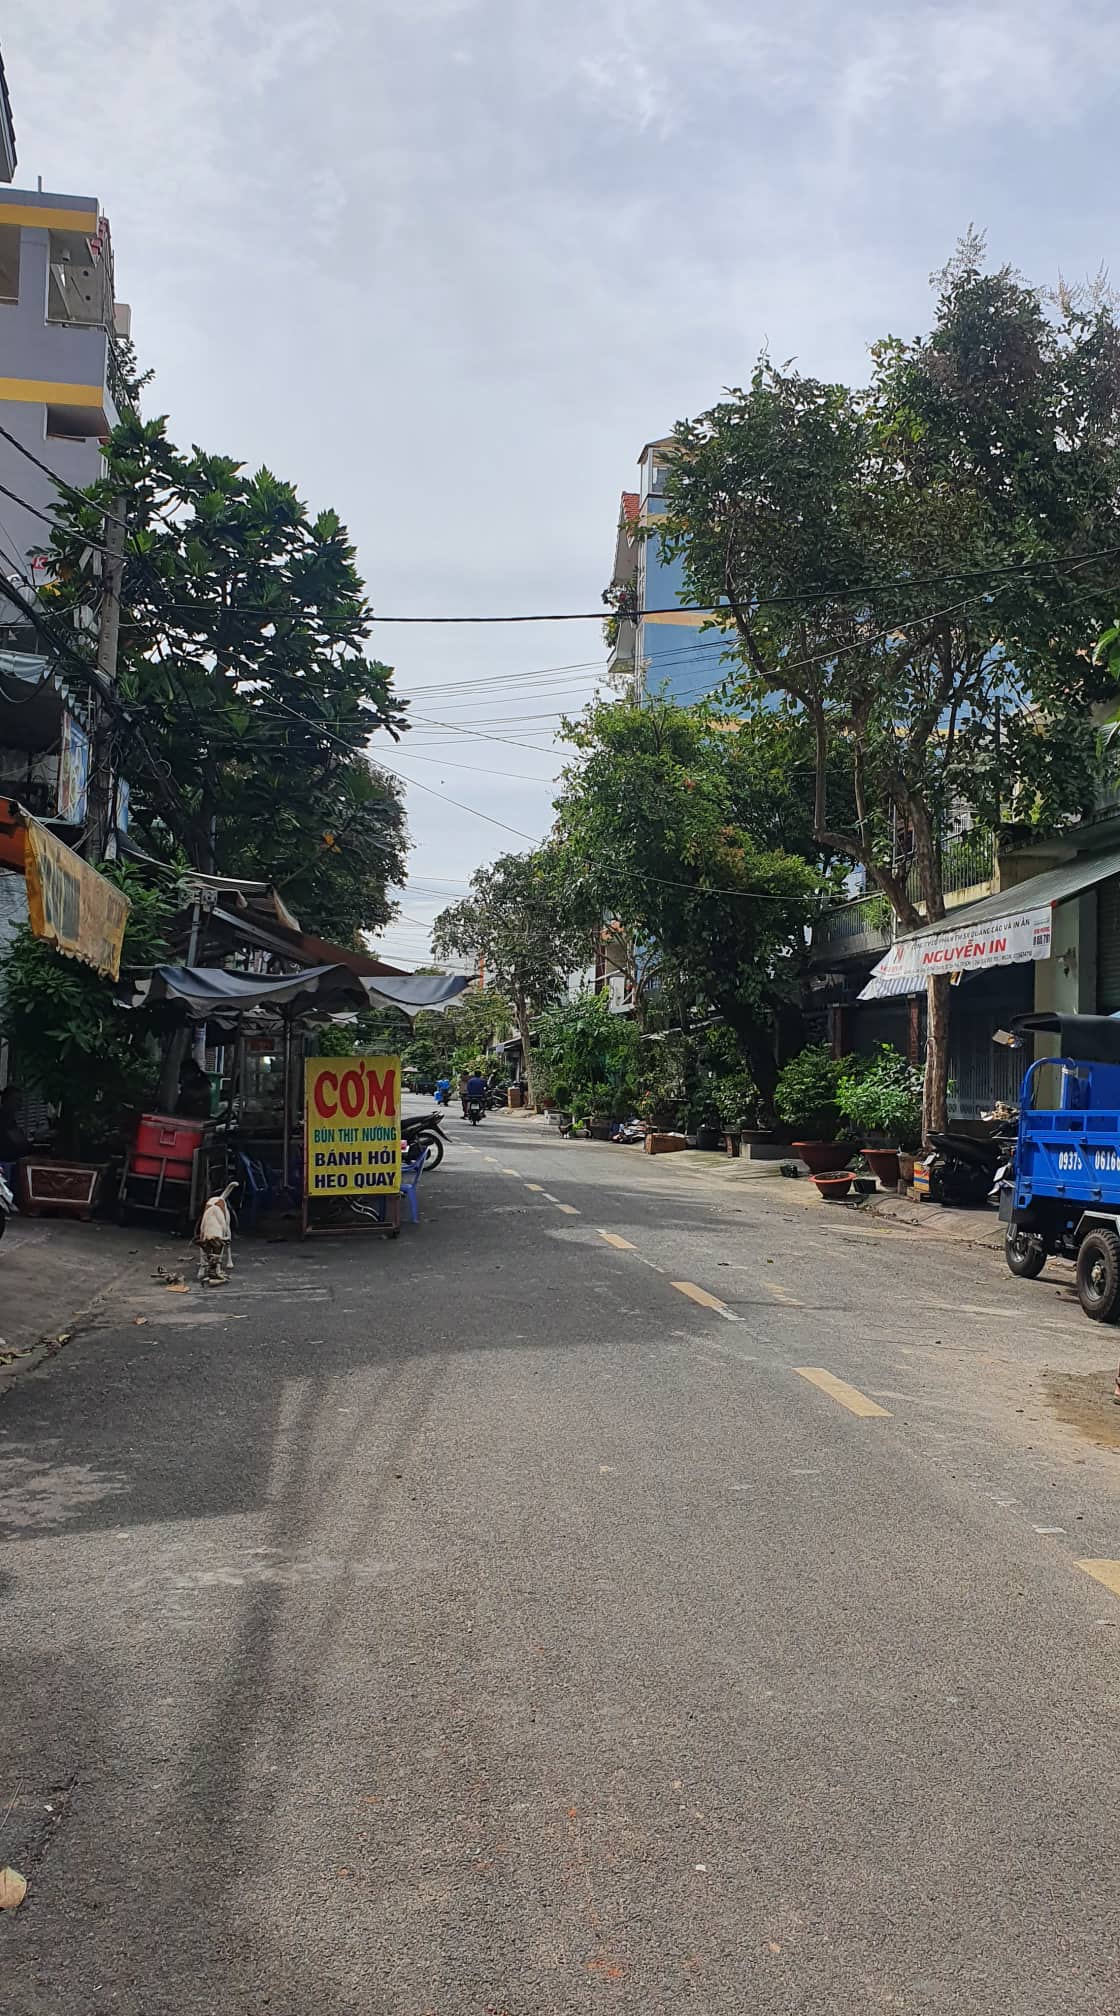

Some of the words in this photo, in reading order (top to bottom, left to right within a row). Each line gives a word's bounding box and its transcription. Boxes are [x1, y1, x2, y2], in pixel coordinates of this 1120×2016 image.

[922, 938, 986, 965] NGUYỄN
[988, 936, 1007, 954] IN
[314, 1060, 396, 1119] CƠM
[314, 1125, 336, 1143] BÚN
[338, 1127, 360, 1145] THỊT
[362, 1124, 397, 1142] NƯỚNG
[314, 1148, 362, 1167] BÁNH
[368, 1145, 396, 1166] HỎI
[314, 1173, 348, 1189] HEO
[354, 1171, 396, 1188] QUAY
